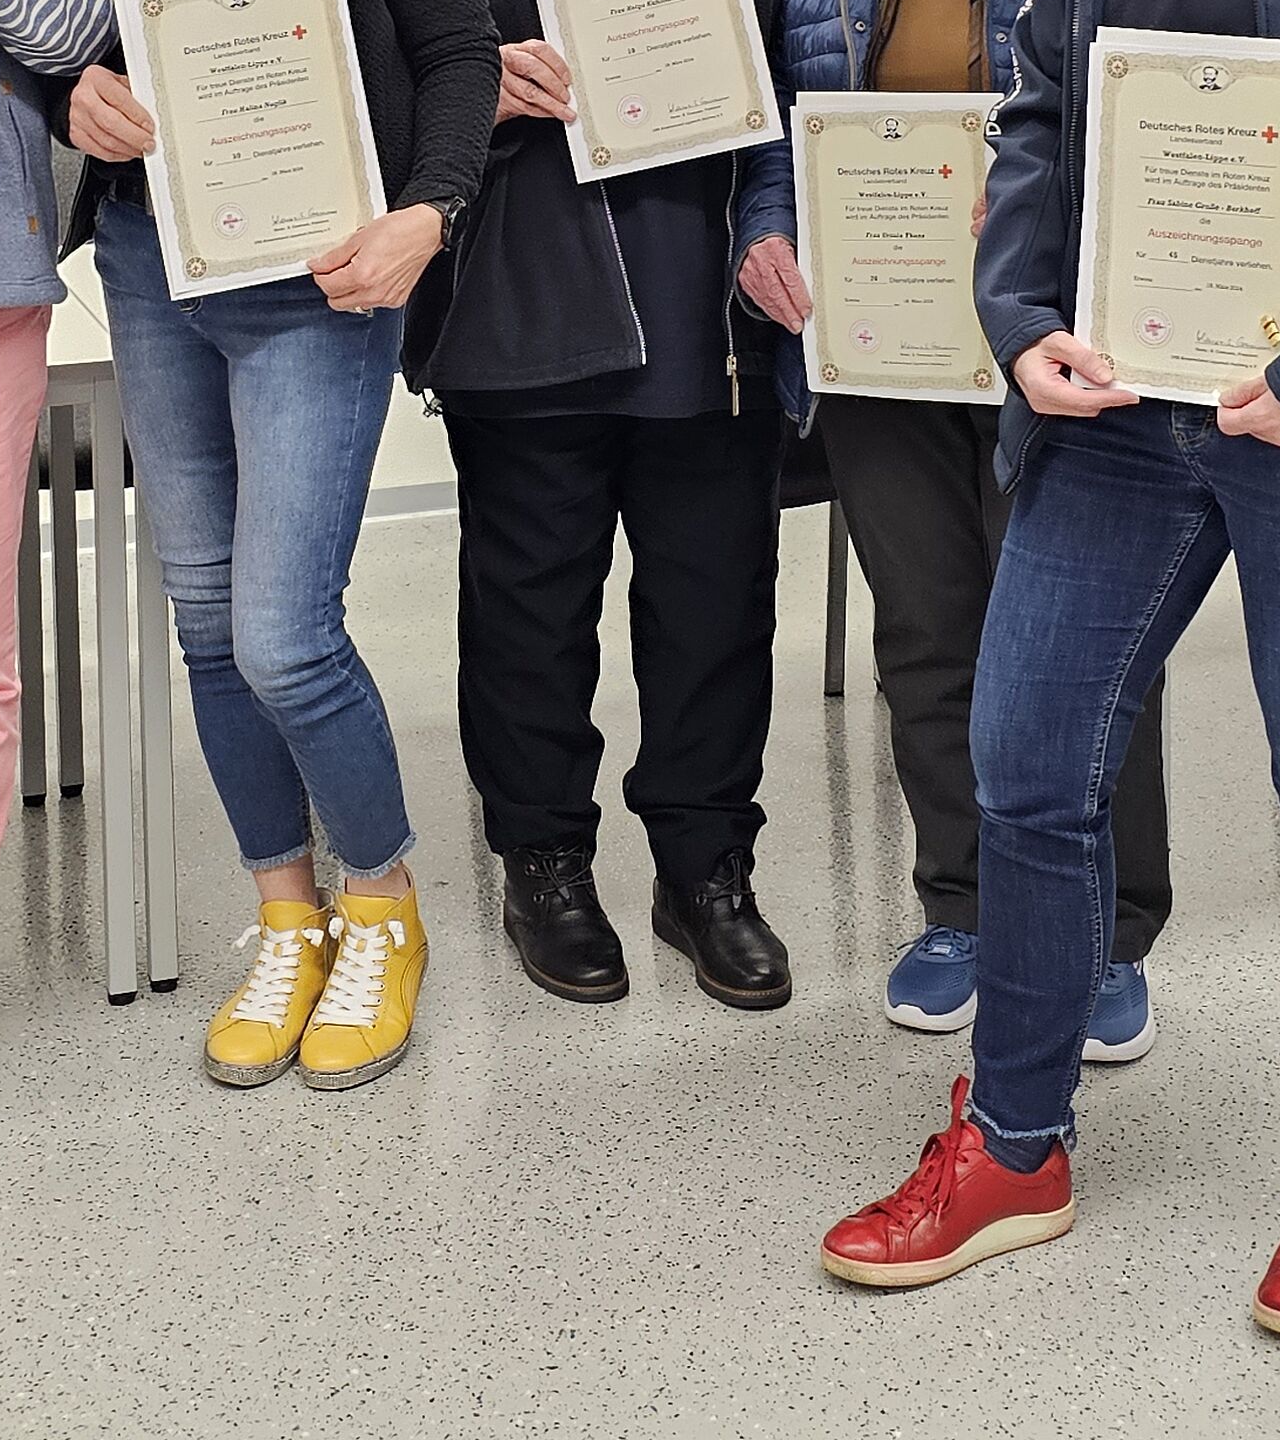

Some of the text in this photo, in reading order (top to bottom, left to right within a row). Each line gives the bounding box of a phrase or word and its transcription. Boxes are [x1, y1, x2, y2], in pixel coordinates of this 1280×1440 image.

[184, 31, 288, 54] Deutsches Rotes Kreuz
[1140, 121, 1257, 137] Deutsches Rotes Kreuz
[1167, 200, 1192, 208] Sabine
[1148, 229, 1262, 248] Auszeichnungsspange
